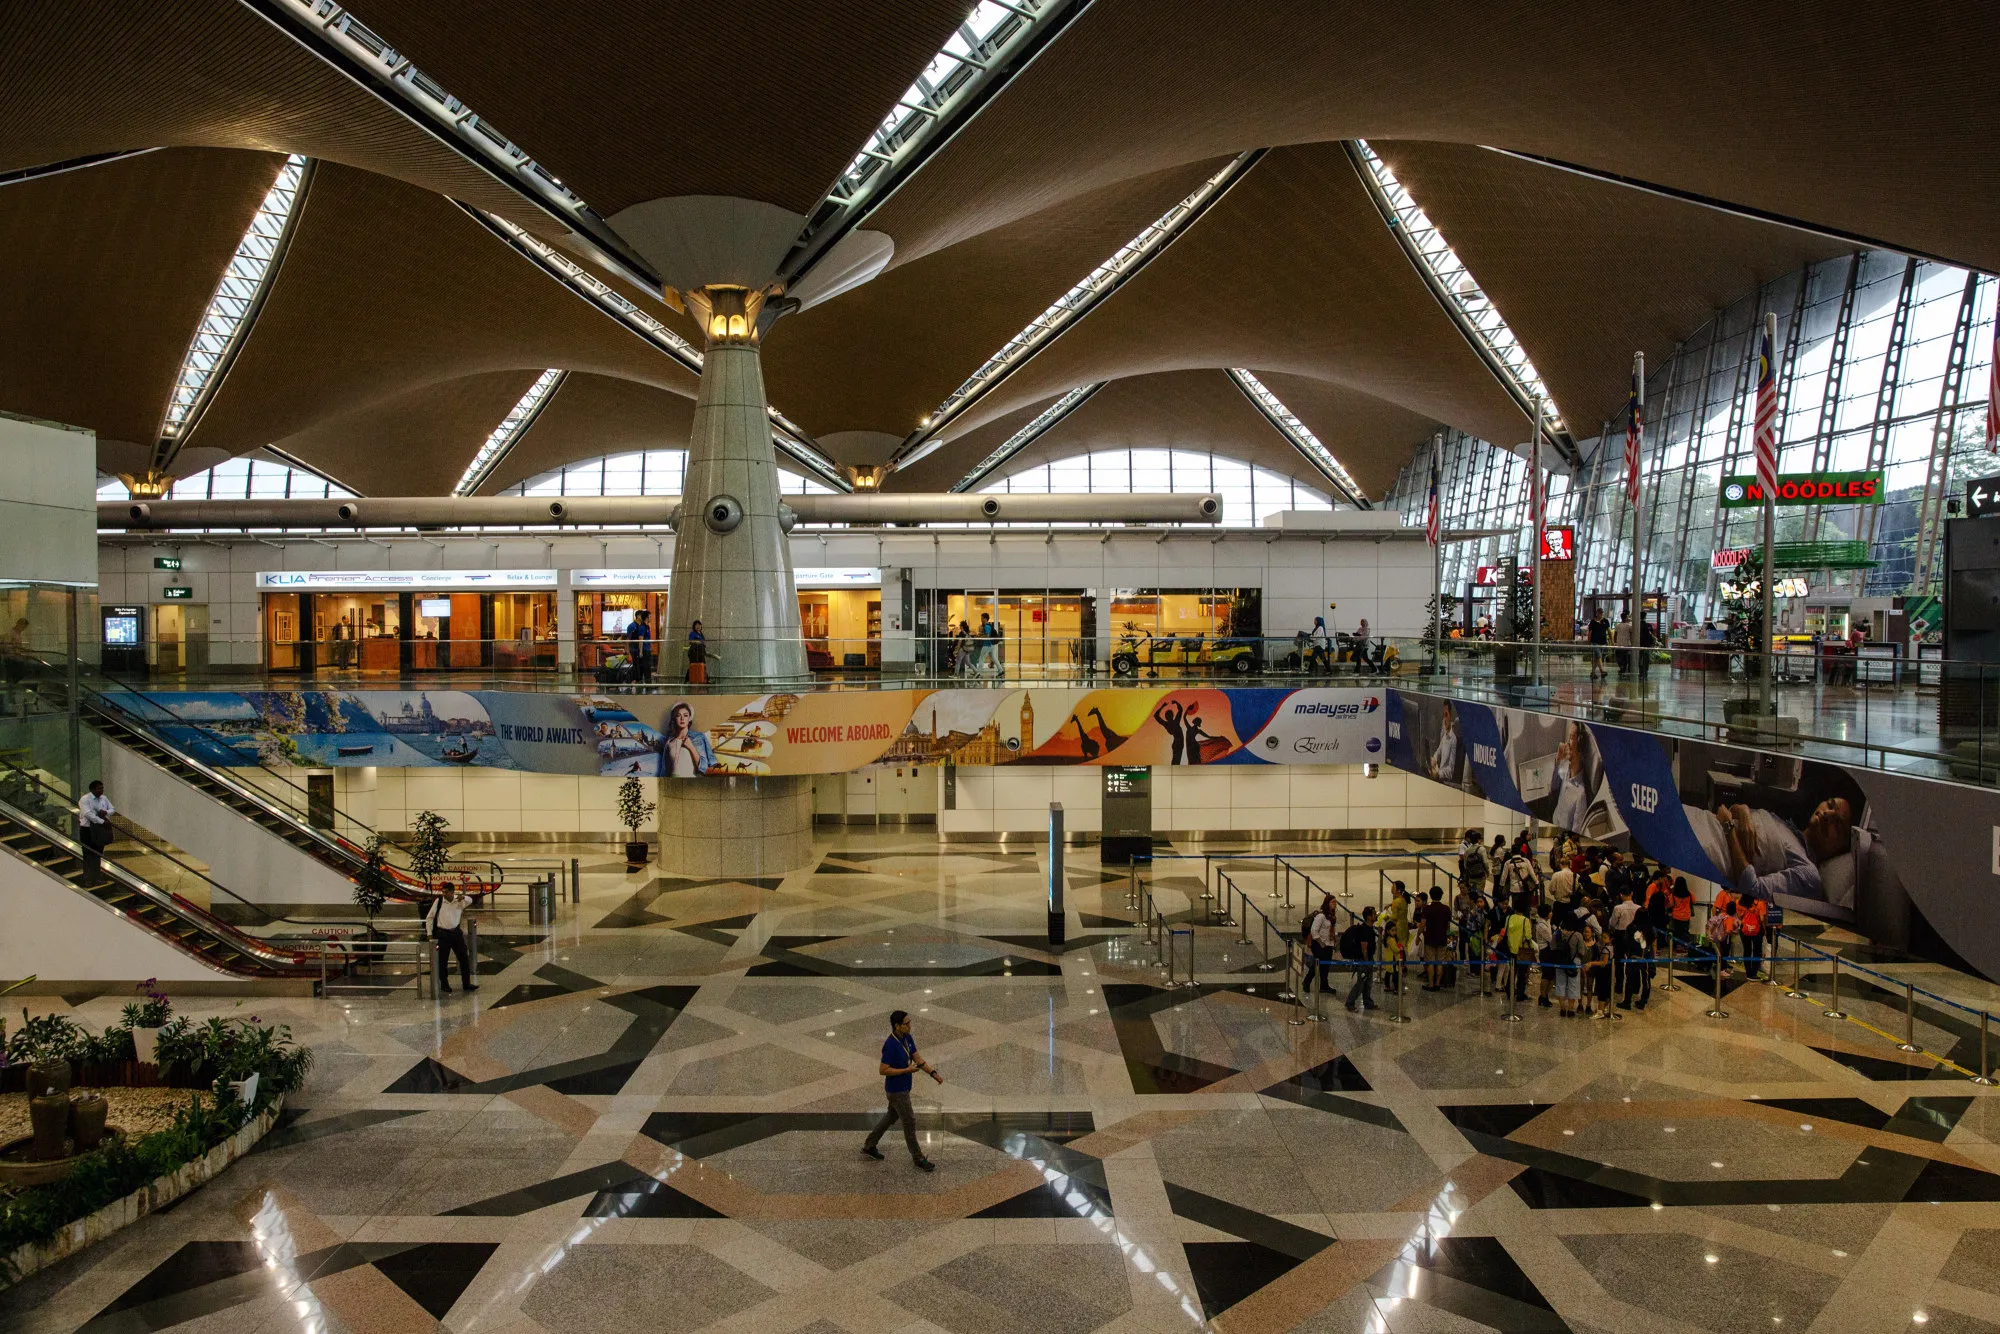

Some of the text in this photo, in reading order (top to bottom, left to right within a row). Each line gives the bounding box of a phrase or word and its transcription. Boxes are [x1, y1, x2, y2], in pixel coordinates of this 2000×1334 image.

[1747, 480, 1875, 500] NÖÖDLES
[265, 574, 414, 585] KLIA Premier Access
[531, 573, 553, 581] Lounge
[1294, 702, 1359, 718] malaysia
[501, 723, 586, 745] THE WORLD AWAITS.
[786, 723, 893, 744] WELCOME ABOARD.
[1293, 736, 1340, 754] Enrich
[1473, 742, 1497, 768] INDULGE
[1631, 783, 1659, 814] SLEEP
[312, 928, 348, 936] CAUTION
